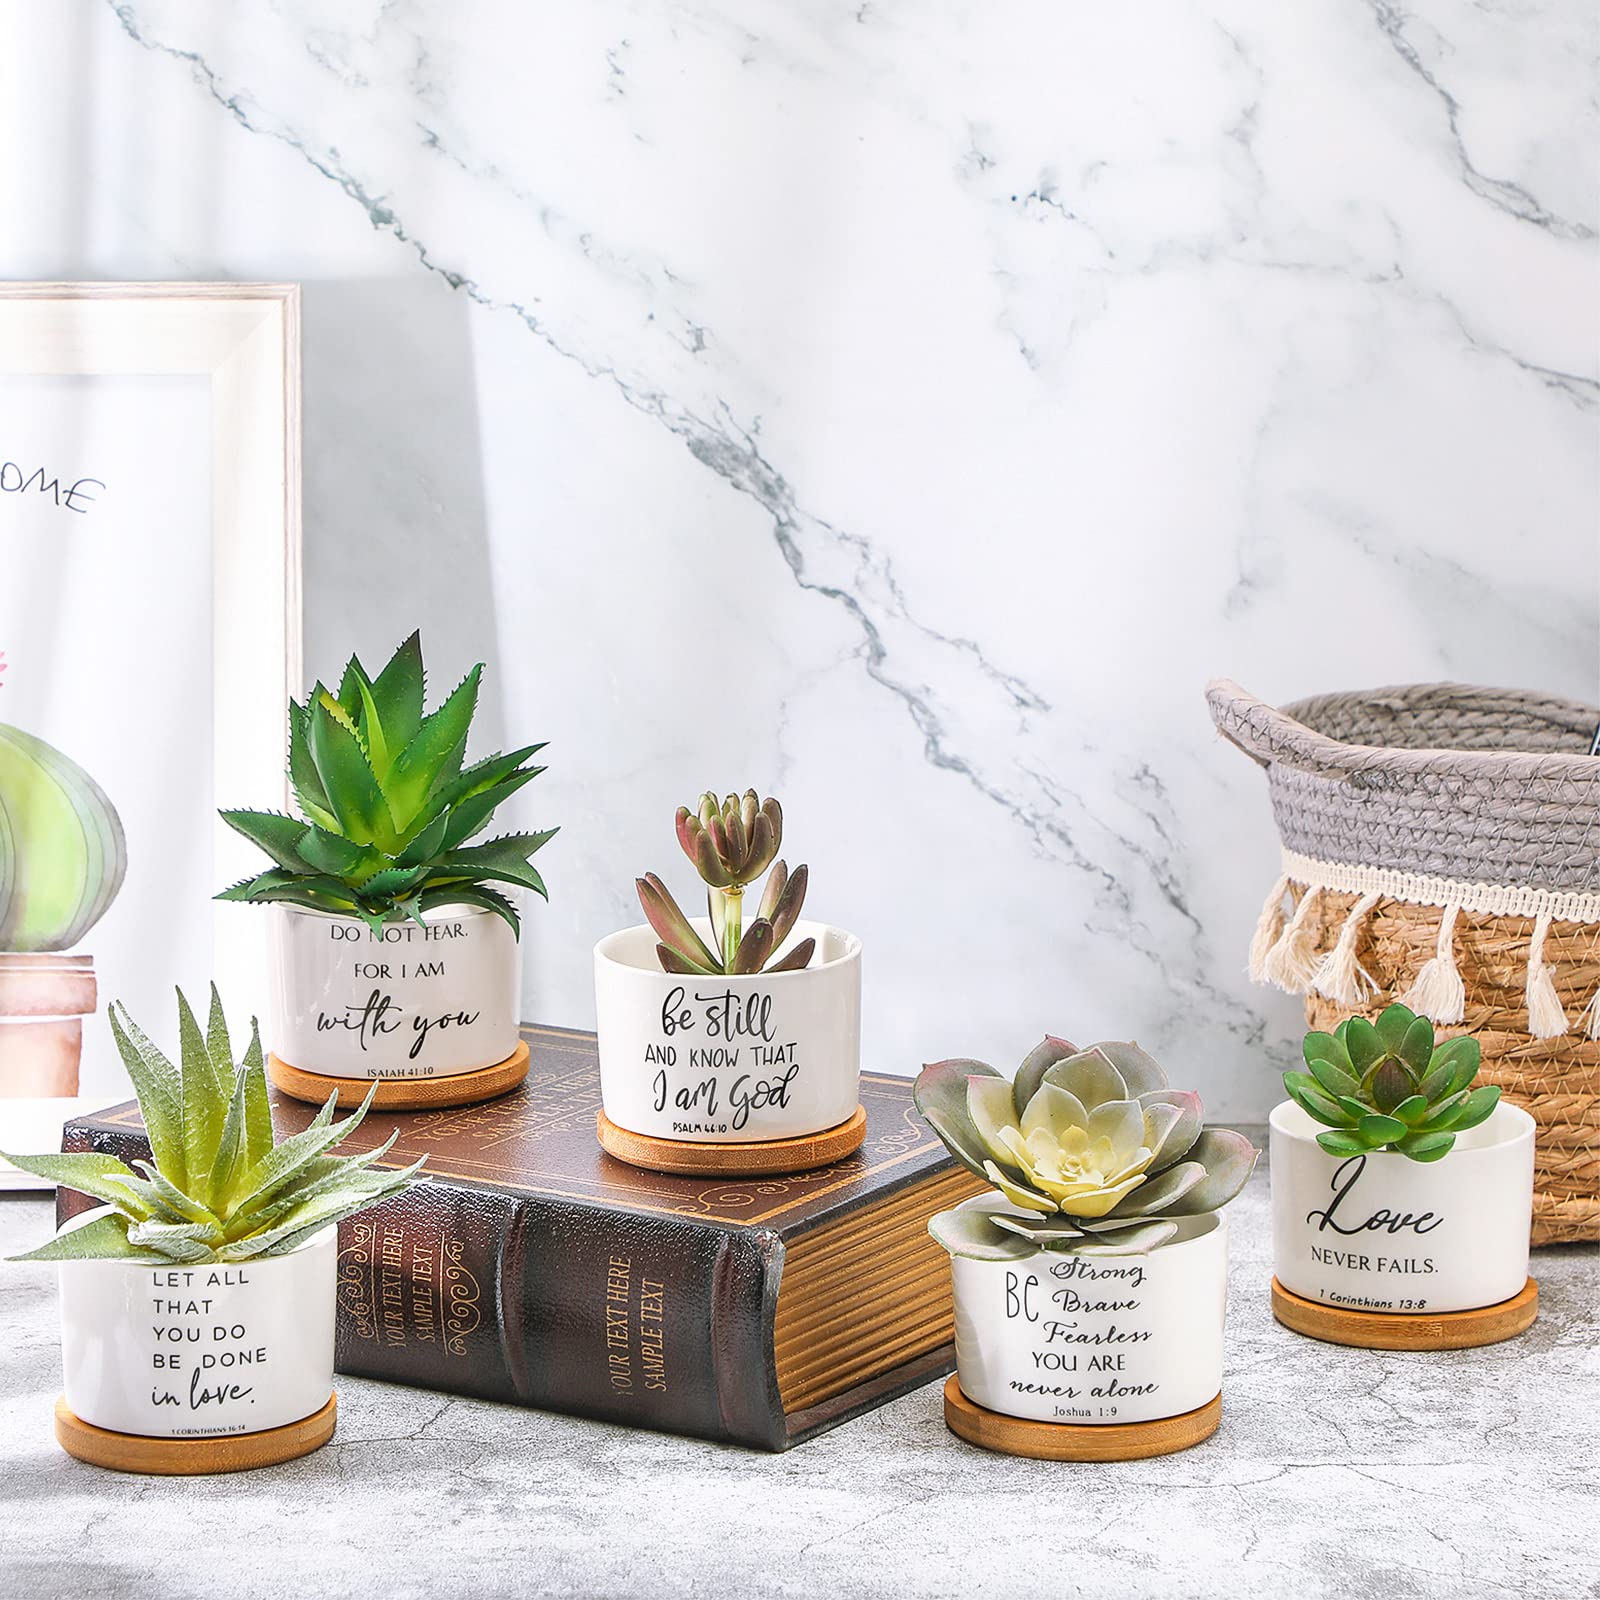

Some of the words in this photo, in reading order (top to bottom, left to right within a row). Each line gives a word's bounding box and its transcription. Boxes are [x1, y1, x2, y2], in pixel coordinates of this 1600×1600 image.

[331, 925, 361, 942] DO
[425, 923, 468, 942] FEAR.
[354, 963, 392, 979] FOR
[402, 964, 406, 978] I
[415, 961, 445, 978] AM
[317, 989, 402, 1051] with
[409, 1011, 480, 1059] you
[661, 986, 696, 1036] be
[695, 989, 777, 1042] still
[644, 1043, 677, 1067] AND
[689, 1048, 740, 1068] KNOW
[750, 1043, 797, 1066] THAT
[367, 1068, 405, 1078] ISAIAH
[408, 1066, 434, 1077] 41:10
[653, 1070, 667, 1112] I
[729, 1064, 799, 1130] God
[673, 1122, 702, 1133] PSALM
[704, 1122, 728, 1133] 46:10
[1307, 1154, 1444, 1235] Love
[382, 1227, 404, 1267] HERE
[1311, 1245, 1371, 1272] NEVER
[1377, 1257, 1439, 1274] FAILS.
[412, 1244, 434, 1282] TEXT
[1050, 1257, 1147, 1288] Strong
[153, 1271, 194, 1288] LET
[207, 1270, 249, 1287] ALL
[382, 1268, 403, 1307] TEXT
[606, 1255, 631, 1303] HERE
[153, 1299, 213, 1315] THAT
[640, 1278, 664, 1322] TEXT
[1052, 1289, 1140, 1313] Brave
[1319, 1289, 1325, 1298] 1
[1330, 1292, 1392, 1309] Corinthians
[1400, 1299, 1427, 1310] 13:8
[412, 1286, 436, 1343] SAMPLE
[606, 1305, 629, 1349] TEXT
[153, 1326, 200, 1342] YOU
[213, 1324, 246, 1341] DO
[1043, 1321, 1152, 1345] Fearless
[153, 1353, 181, 1370] BE
[202, 1347, 267, 1369] DONE
[640, 1326, 667, 1392] SAMPLE
[1032, 1351, 1077, 1372] YOU
[1087, 1354, 1126, 1372] ARE
[152, 1386, 180, 1407] in
[190, 1367, 255, 1411] love.
[1009, 1380, 1081, 1398] never
[1091, 1379, 1159, 1397] alone
[1053, 1406, 1092, 1418] Joshua
[1099, 1406, 1118, 1417] 1:9
[177, 1426, 227, 1436] CORINTHIANS
